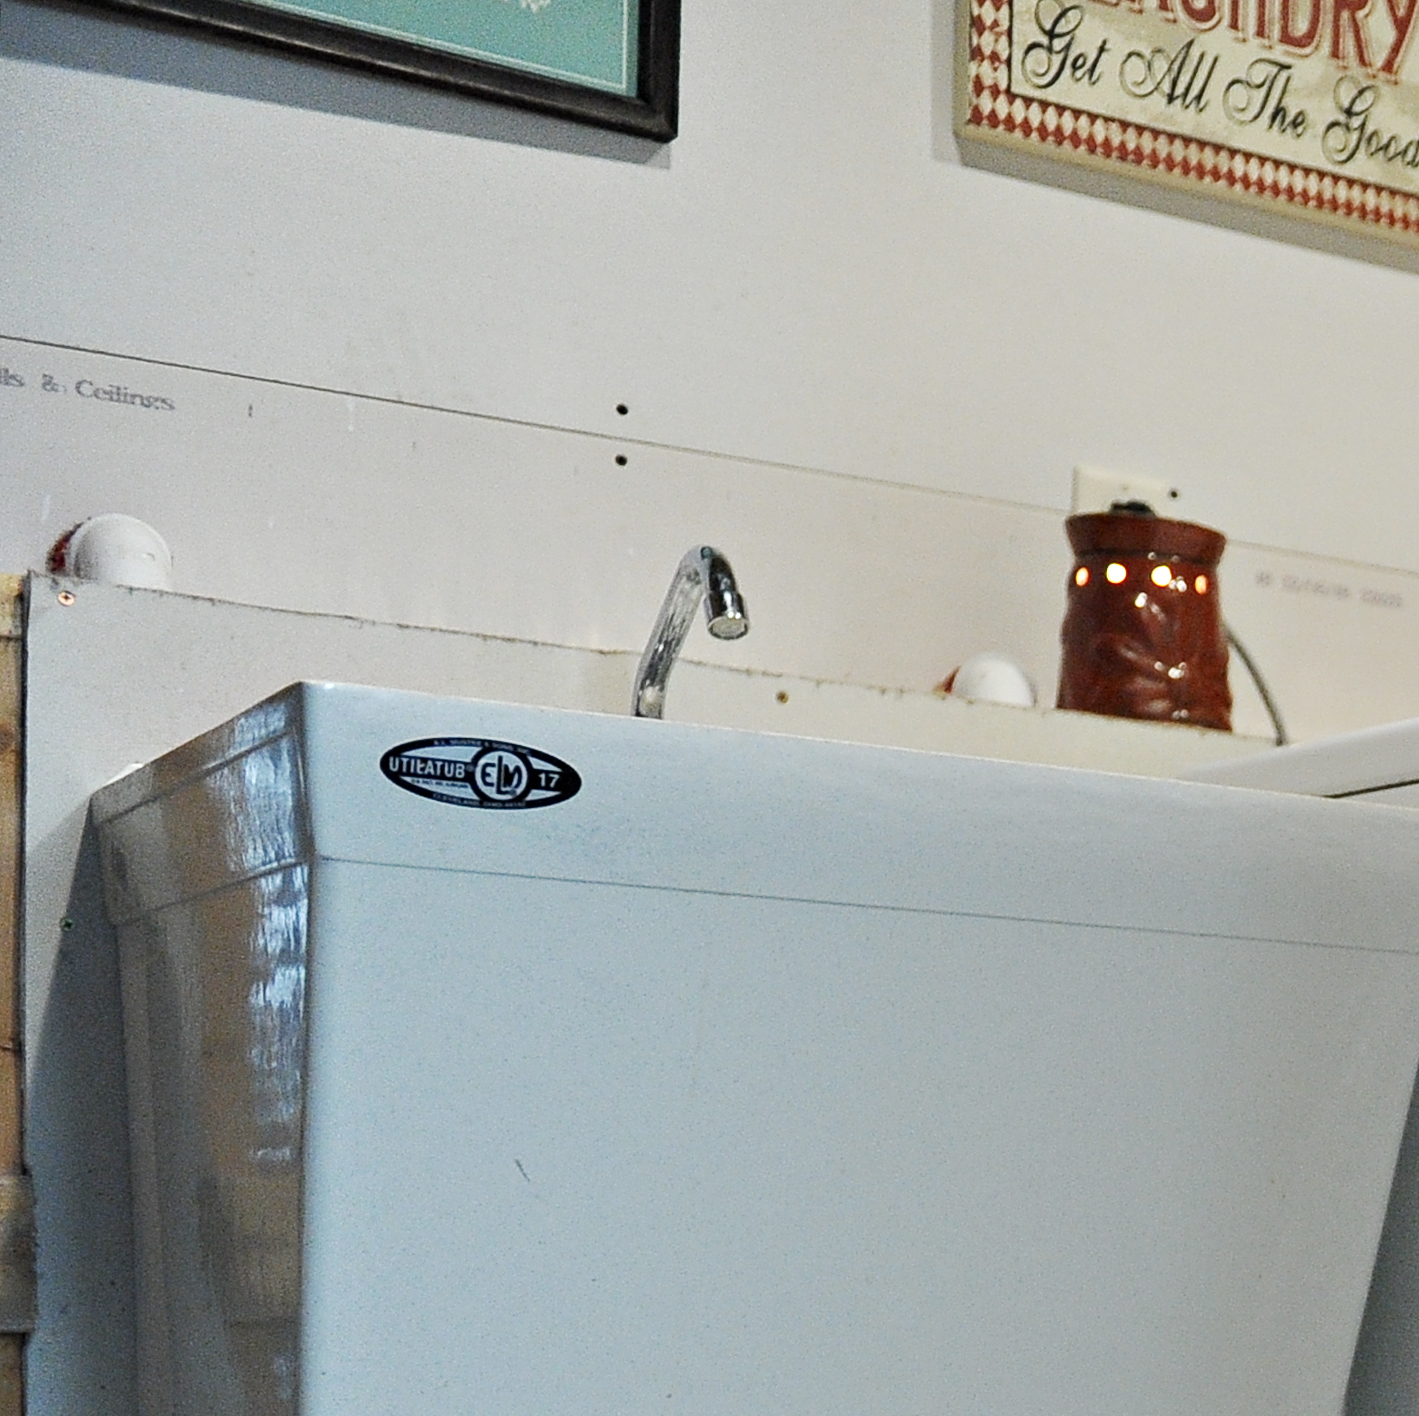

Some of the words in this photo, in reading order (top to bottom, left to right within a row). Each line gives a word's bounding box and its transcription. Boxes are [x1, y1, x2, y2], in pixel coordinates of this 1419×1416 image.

[1021, 0, 1112, 90] Get
[1119, 38, 1219, 114] All
[1222, 57, 1308, 138] The
[74, 379, 175, 411] Ceilings
[538, 772, 560, 788] 17
